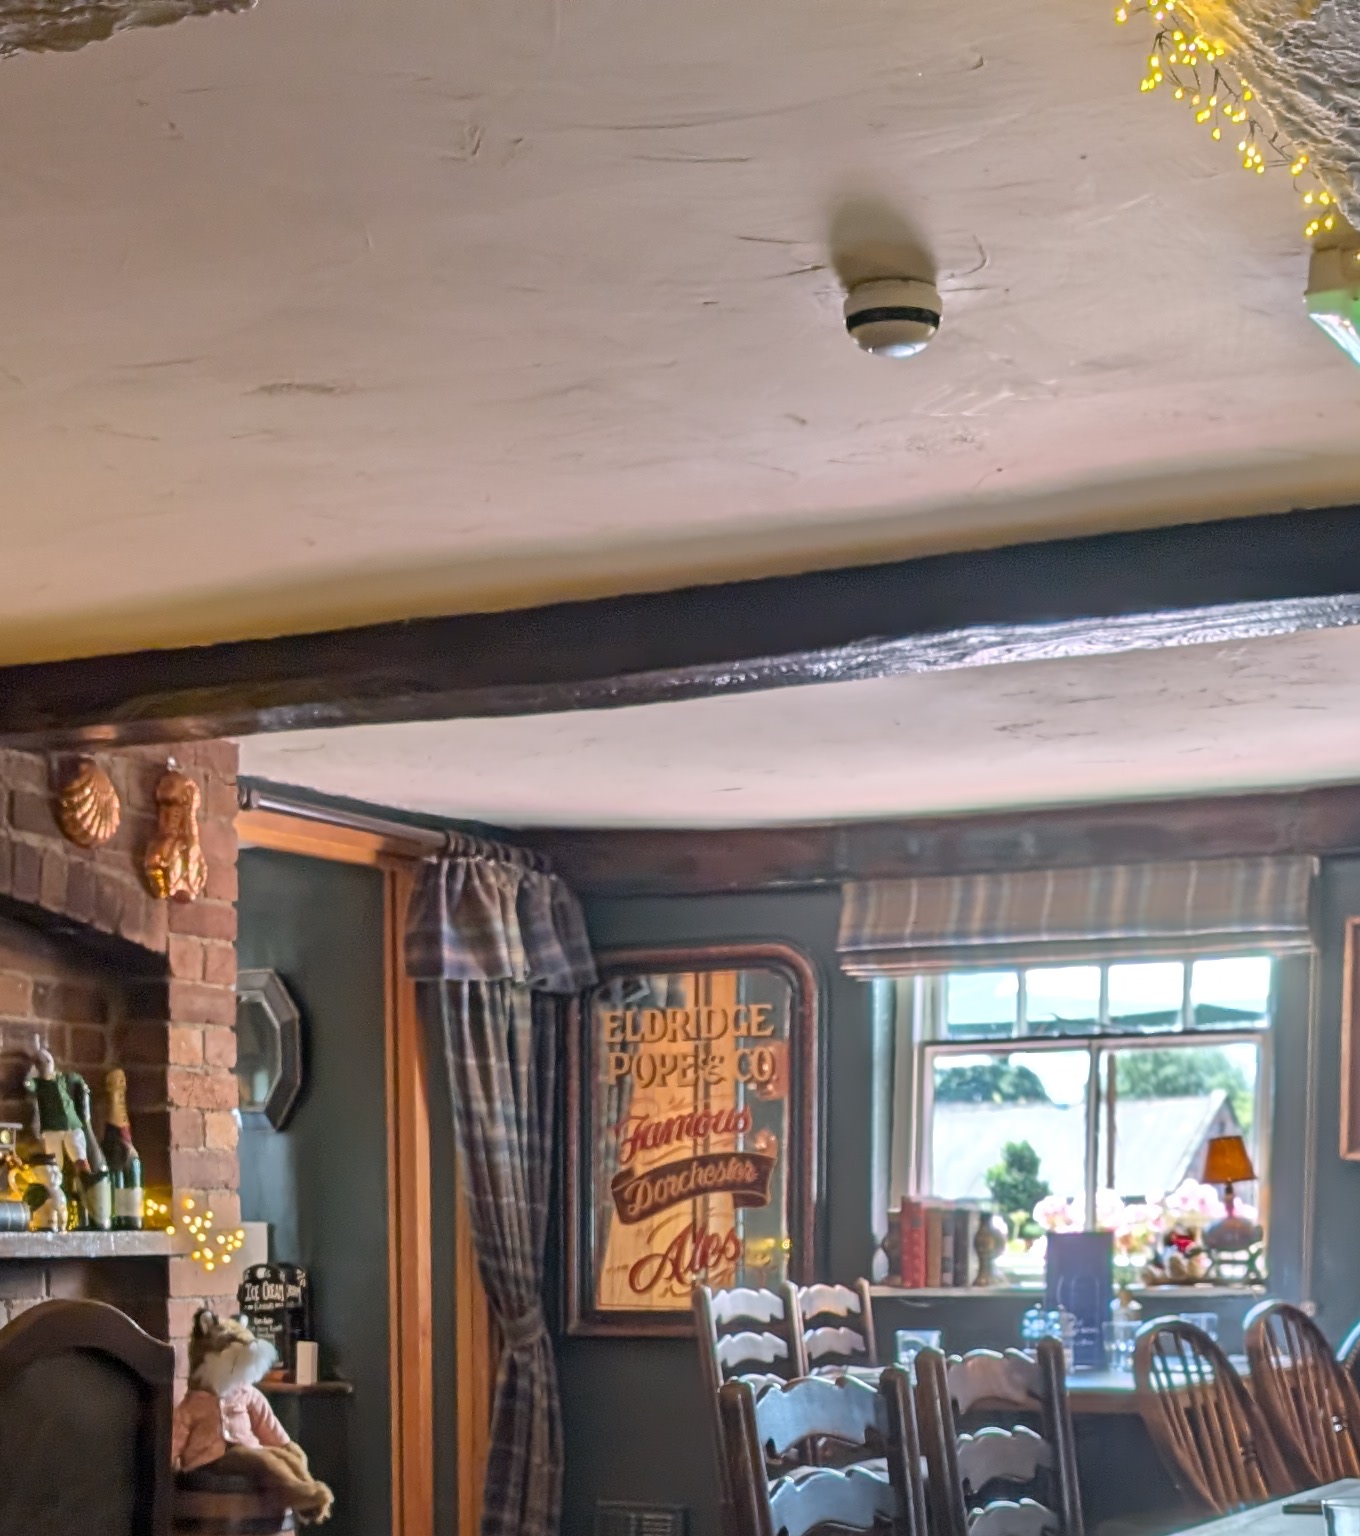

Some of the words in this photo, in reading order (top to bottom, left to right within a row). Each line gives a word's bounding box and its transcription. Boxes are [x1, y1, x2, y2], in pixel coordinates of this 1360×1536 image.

[602, 1003, 775, 1043] ELDRIDGE
[608, 1051, 700, 1089] POPE
[701, 1055, 727, 1086] &
[615, 1105, 753, 1165] Famous
[626, 1157, 759, 1215] Dorchester
[629, 1221, 742, 1294] Ales
